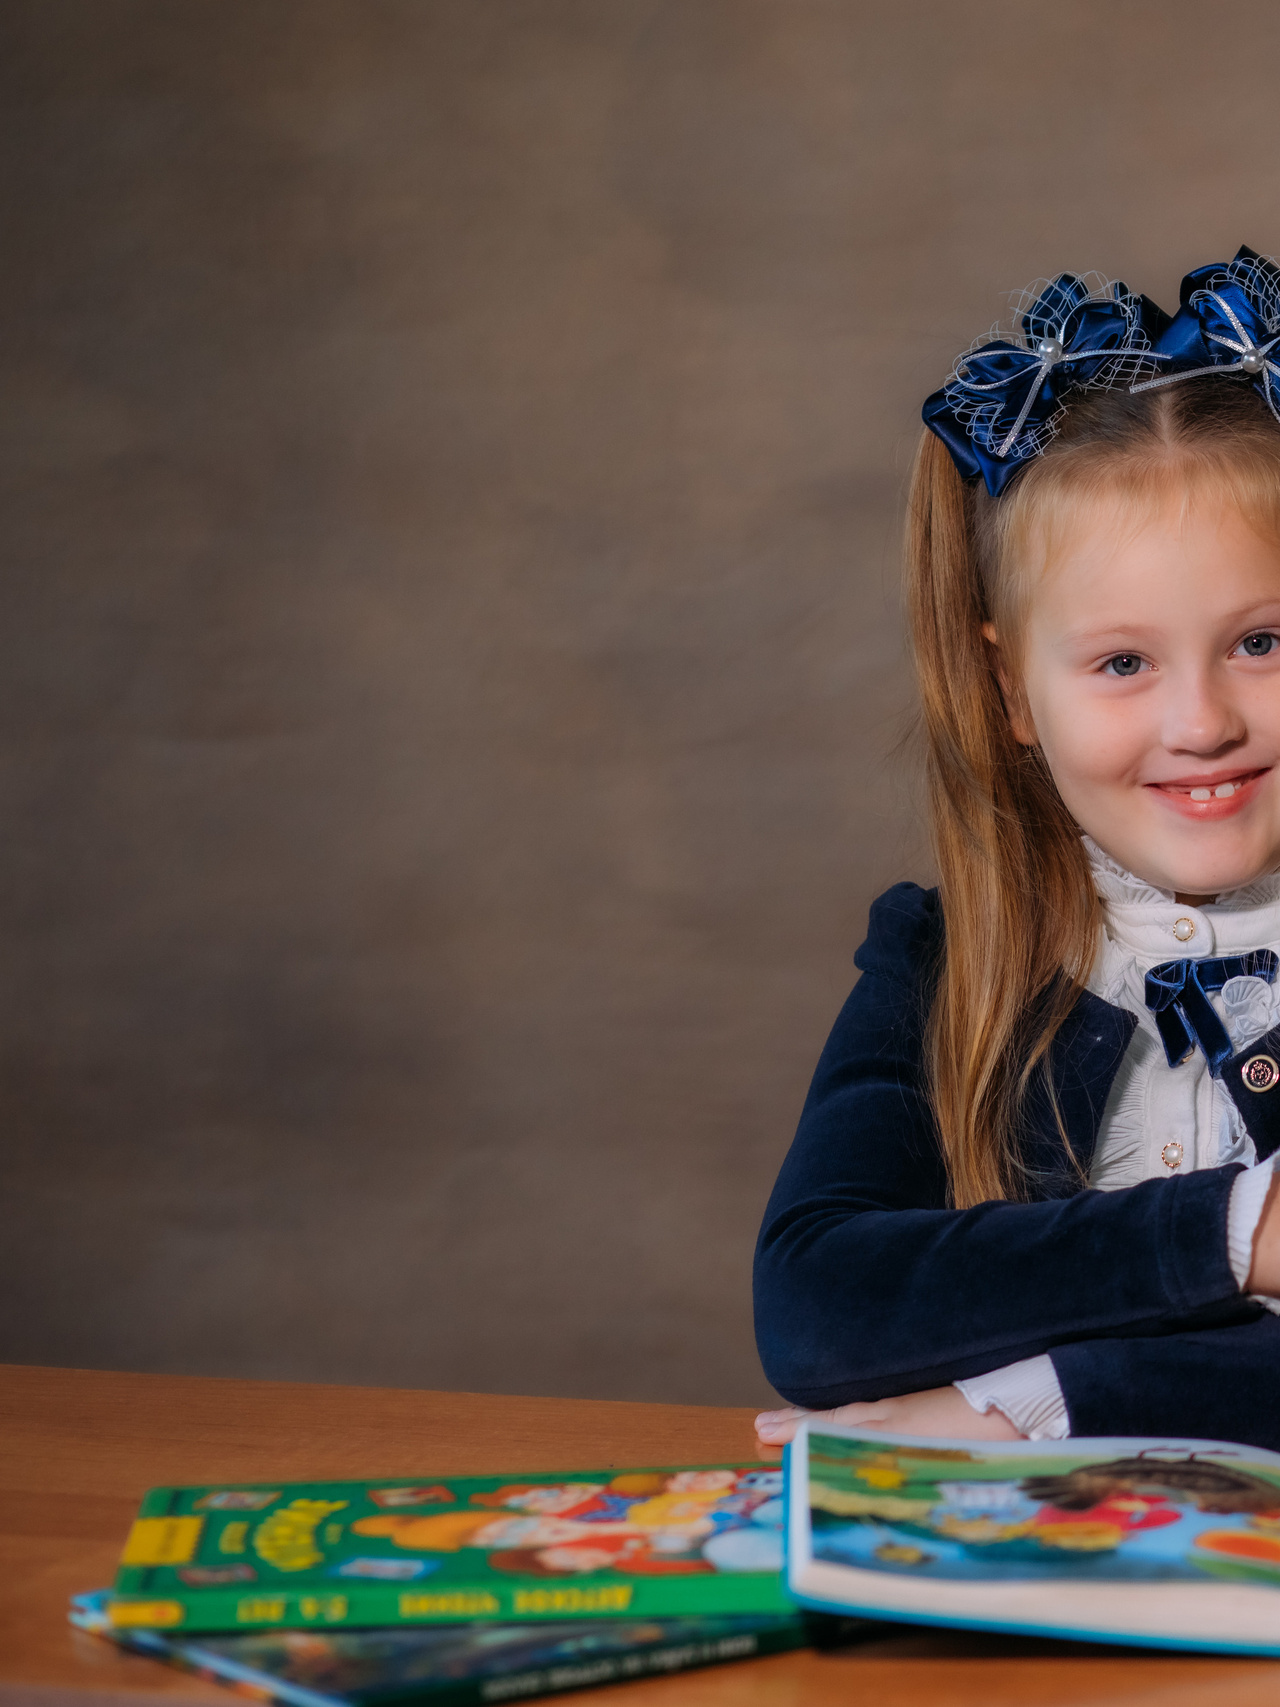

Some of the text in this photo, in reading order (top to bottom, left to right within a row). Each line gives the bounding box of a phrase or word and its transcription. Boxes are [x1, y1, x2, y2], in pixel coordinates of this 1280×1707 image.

[238, 1599, 285, 1622] ЛЕТ
[401, 1594, 498, 1617] ЧТЕНИЕ
[514, 1587, 632, 1613] ДЕТСКОЕ
